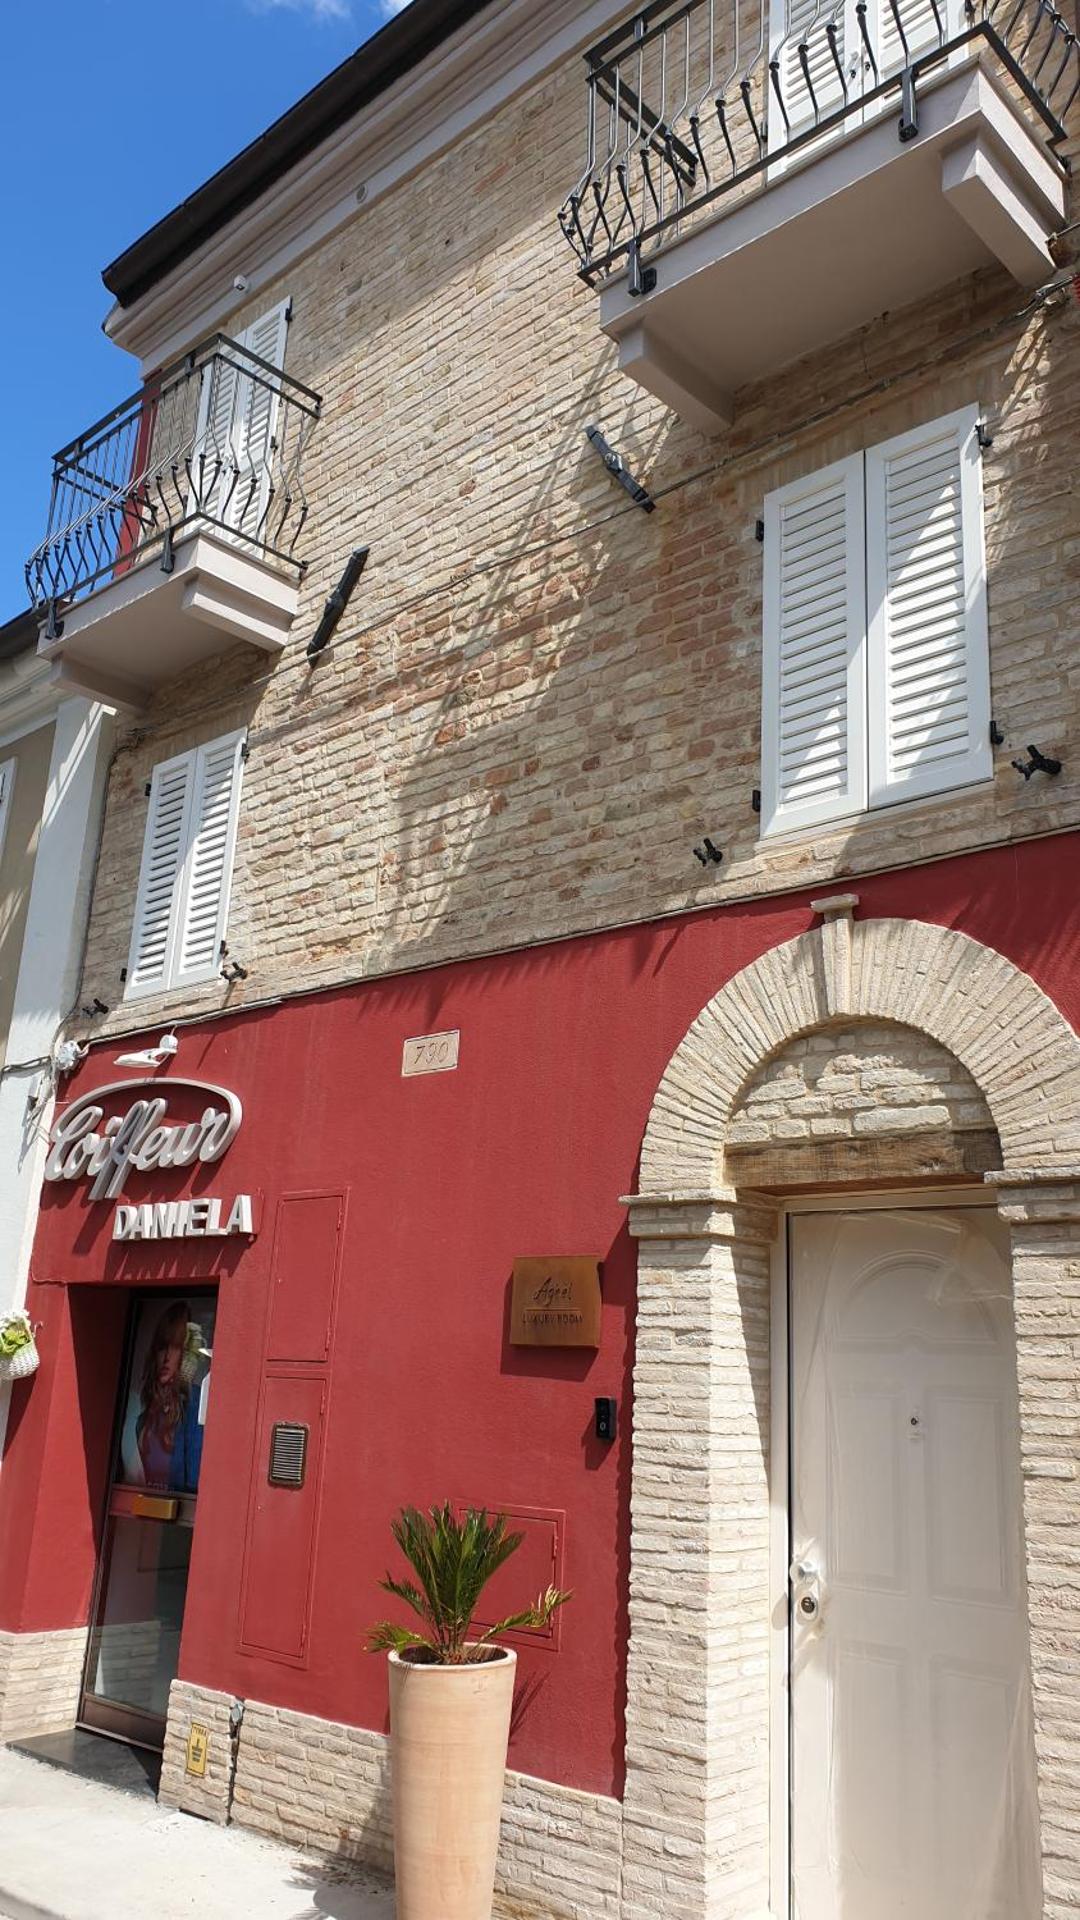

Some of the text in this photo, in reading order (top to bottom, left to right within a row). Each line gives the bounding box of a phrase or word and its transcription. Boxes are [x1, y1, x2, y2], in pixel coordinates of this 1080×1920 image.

[45, 1088, 240, 1200] Coiffeur
[112, 1195, 253, 1240] DANIELA
[522, 1312, 583, 1324] LUXURY ROOM
